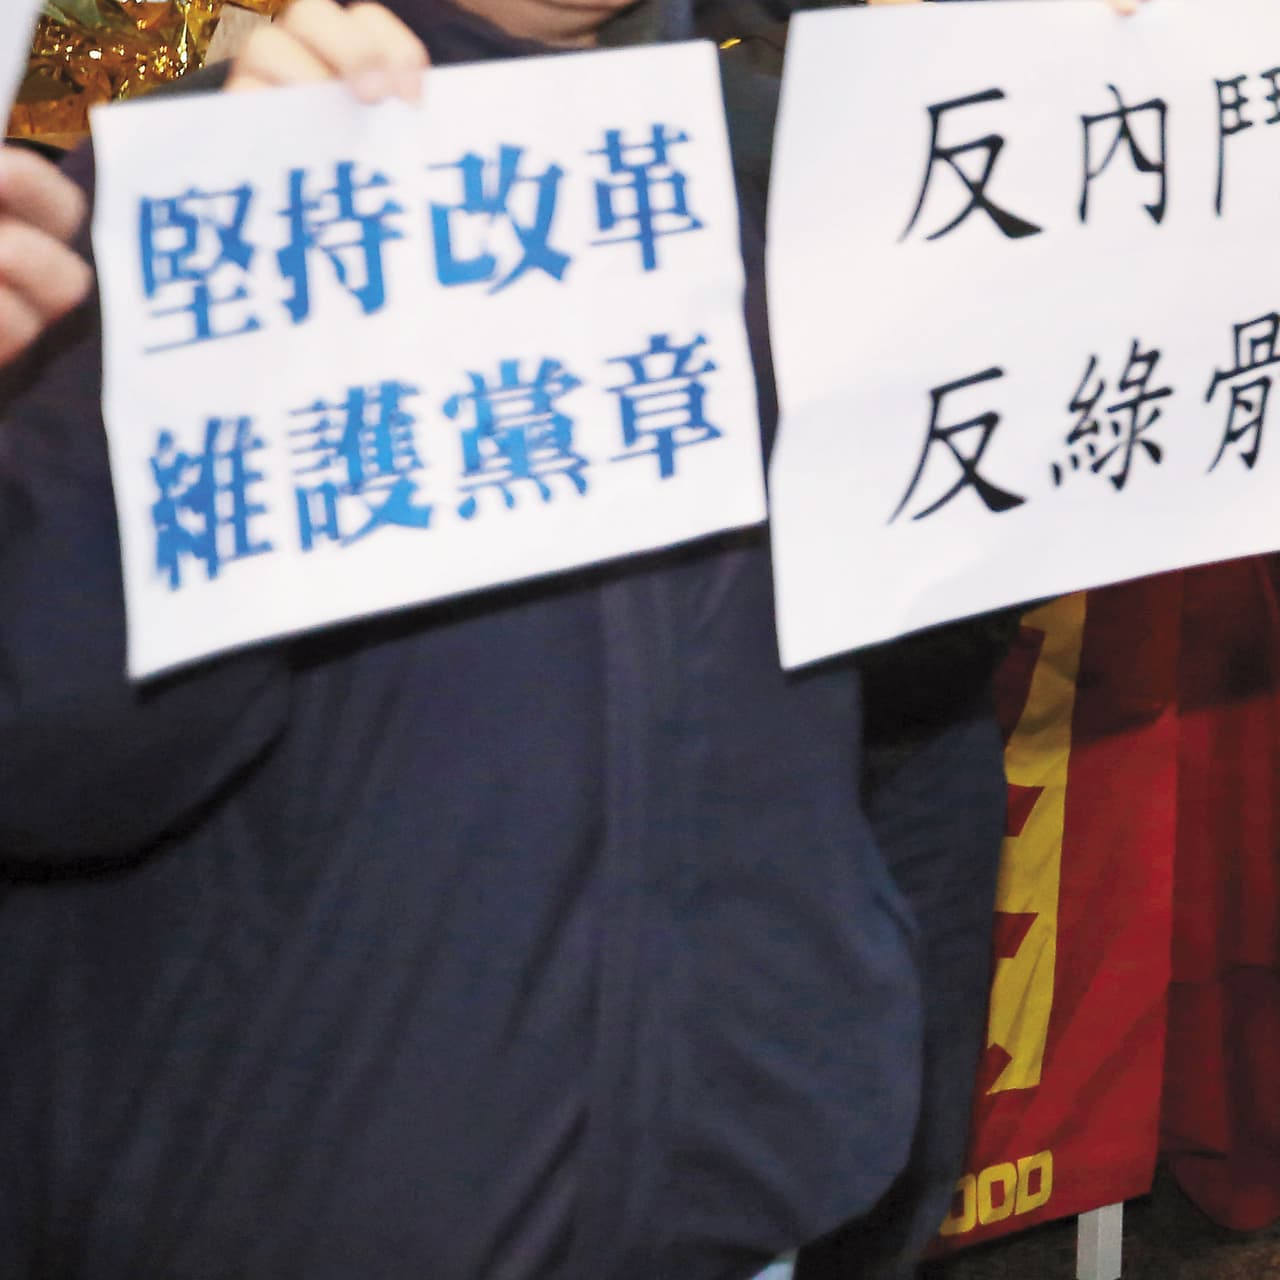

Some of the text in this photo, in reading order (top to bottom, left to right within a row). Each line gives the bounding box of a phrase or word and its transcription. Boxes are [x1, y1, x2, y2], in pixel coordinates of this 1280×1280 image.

[135, 122, 707, 357] 堅持改革
[147, 330, 725, 593] 維護黨章
